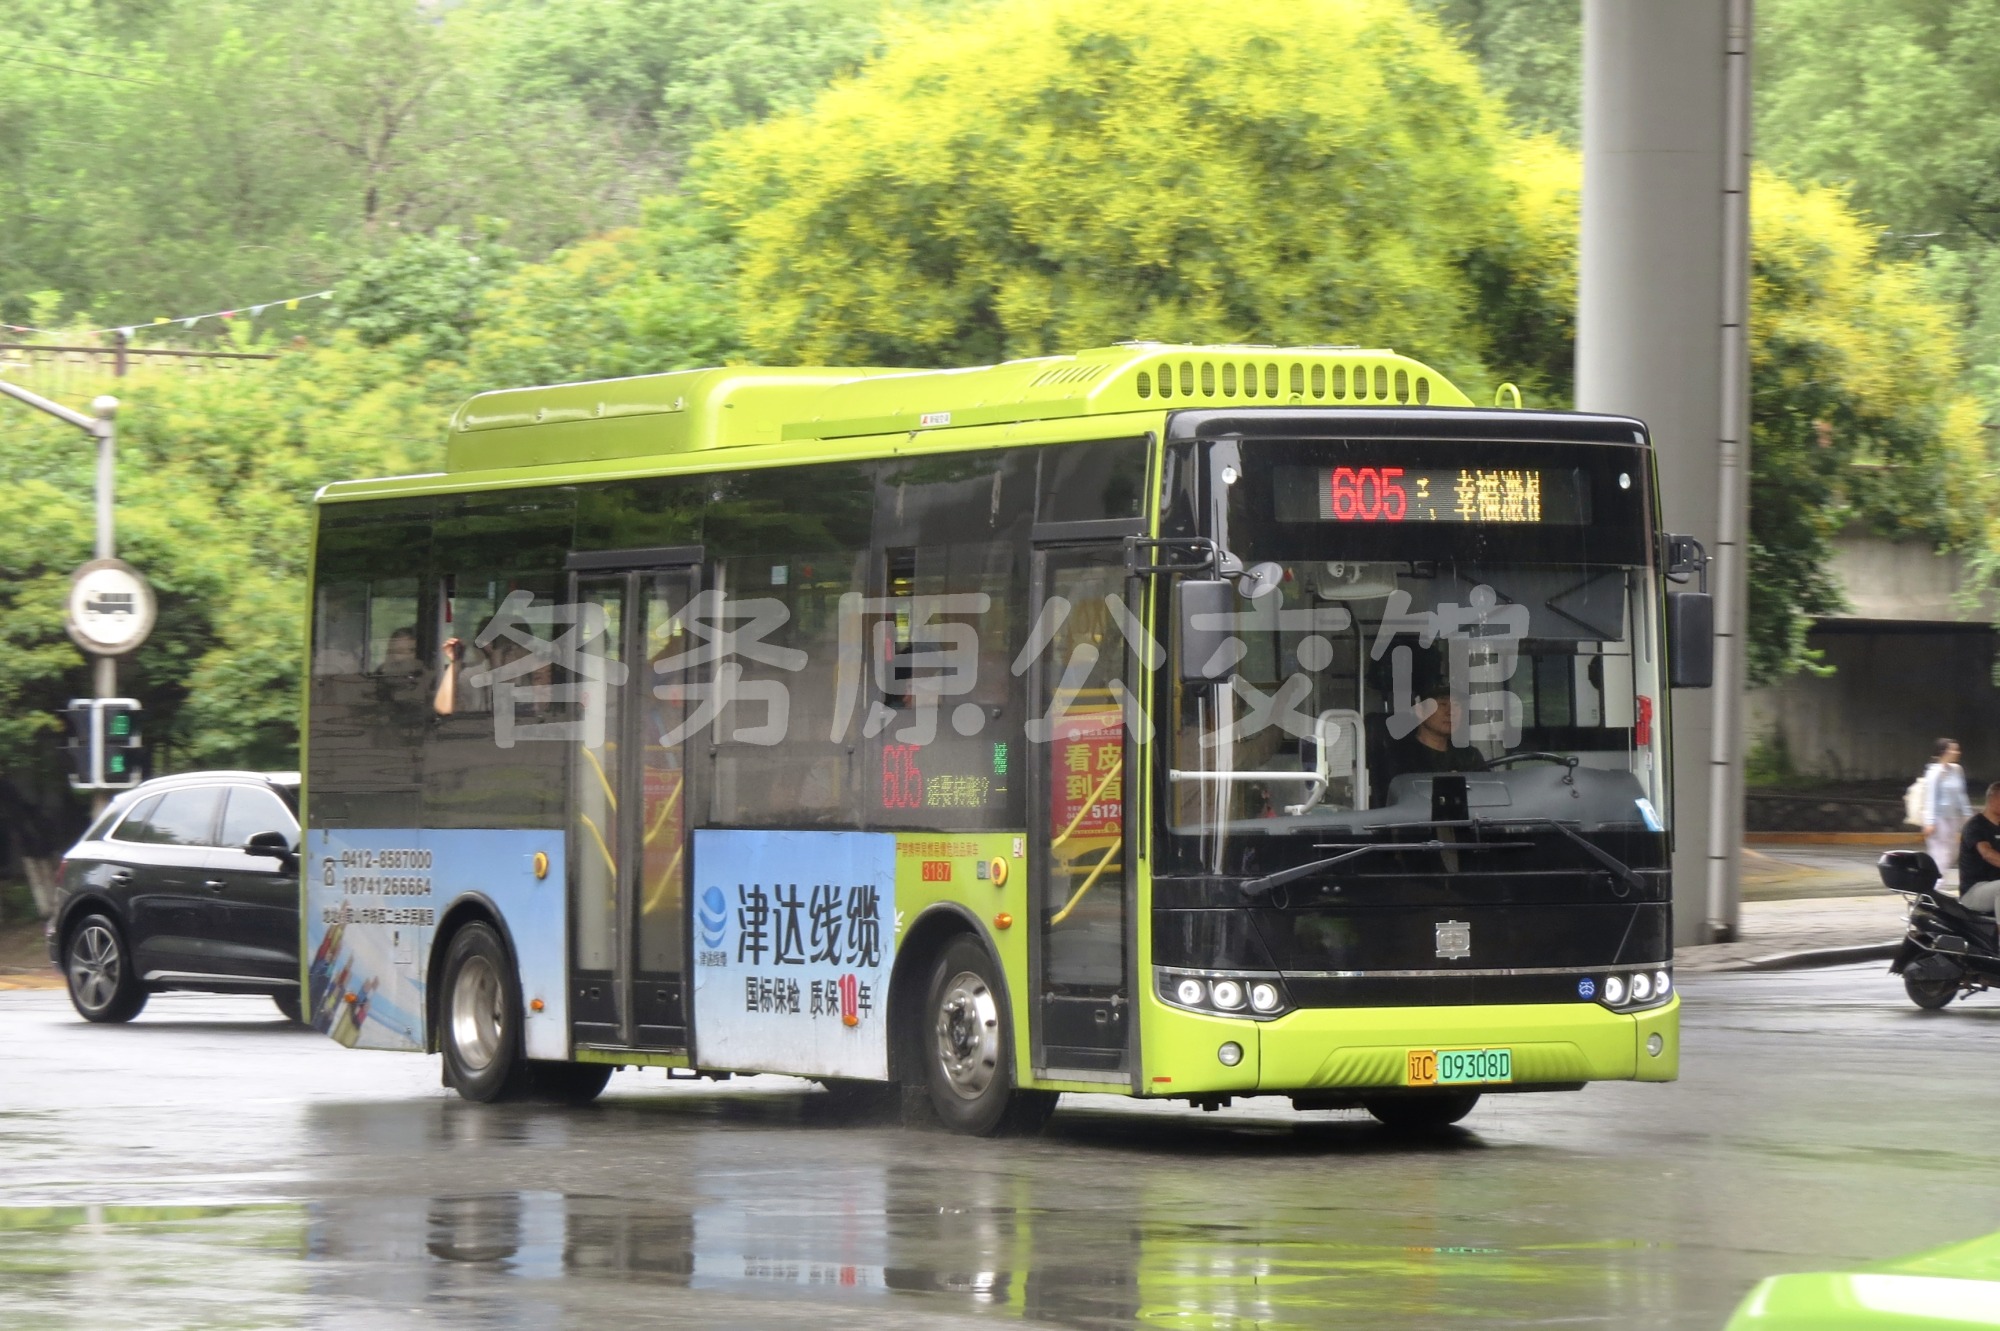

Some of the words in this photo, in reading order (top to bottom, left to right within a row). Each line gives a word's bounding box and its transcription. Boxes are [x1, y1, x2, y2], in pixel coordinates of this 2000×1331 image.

[1331, 467, 1408, 521] 605
[883, 743, 923, 809] 605
[342, 849, 433, 870] 0412-8587000
[923, 862, 950, 881] 3187
[342, 876, 432, 896] 18741266664
[737, 883, 881, 968] 津达线缆
[746, 975, 801, 1015] 国标保检
[1410, 1055, 1434, 1081] 辽C
[1442, 1052, 1510, 1080] 09308D
